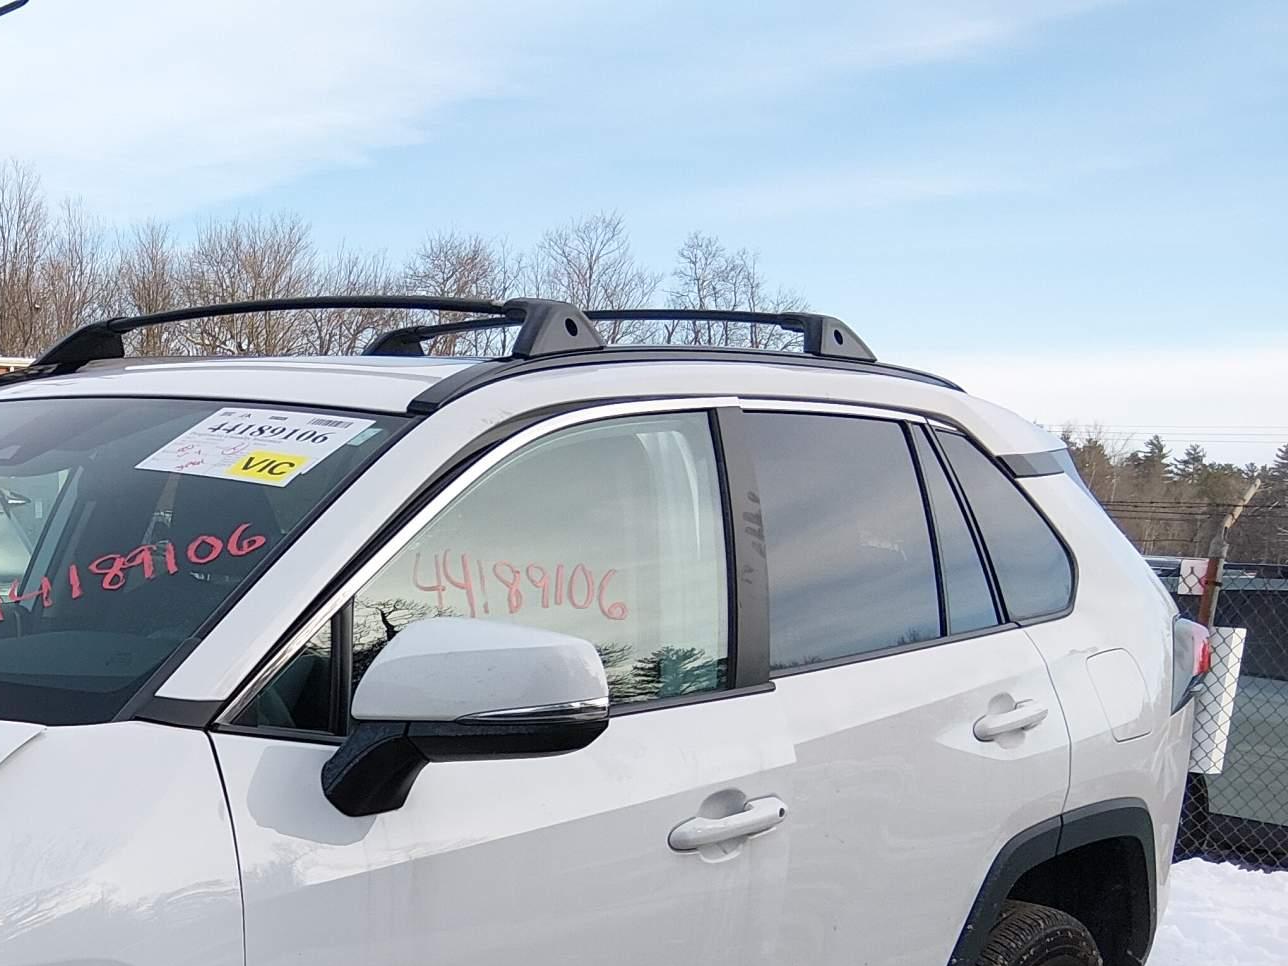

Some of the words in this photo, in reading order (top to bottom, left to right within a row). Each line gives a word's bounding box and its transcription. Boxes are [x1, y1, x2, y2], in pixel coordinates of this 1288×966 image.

[207, 421, 336, 444] 44189106
[242, 456, 295, 477] VIC
[413, 549, 629, 621] 44189106
